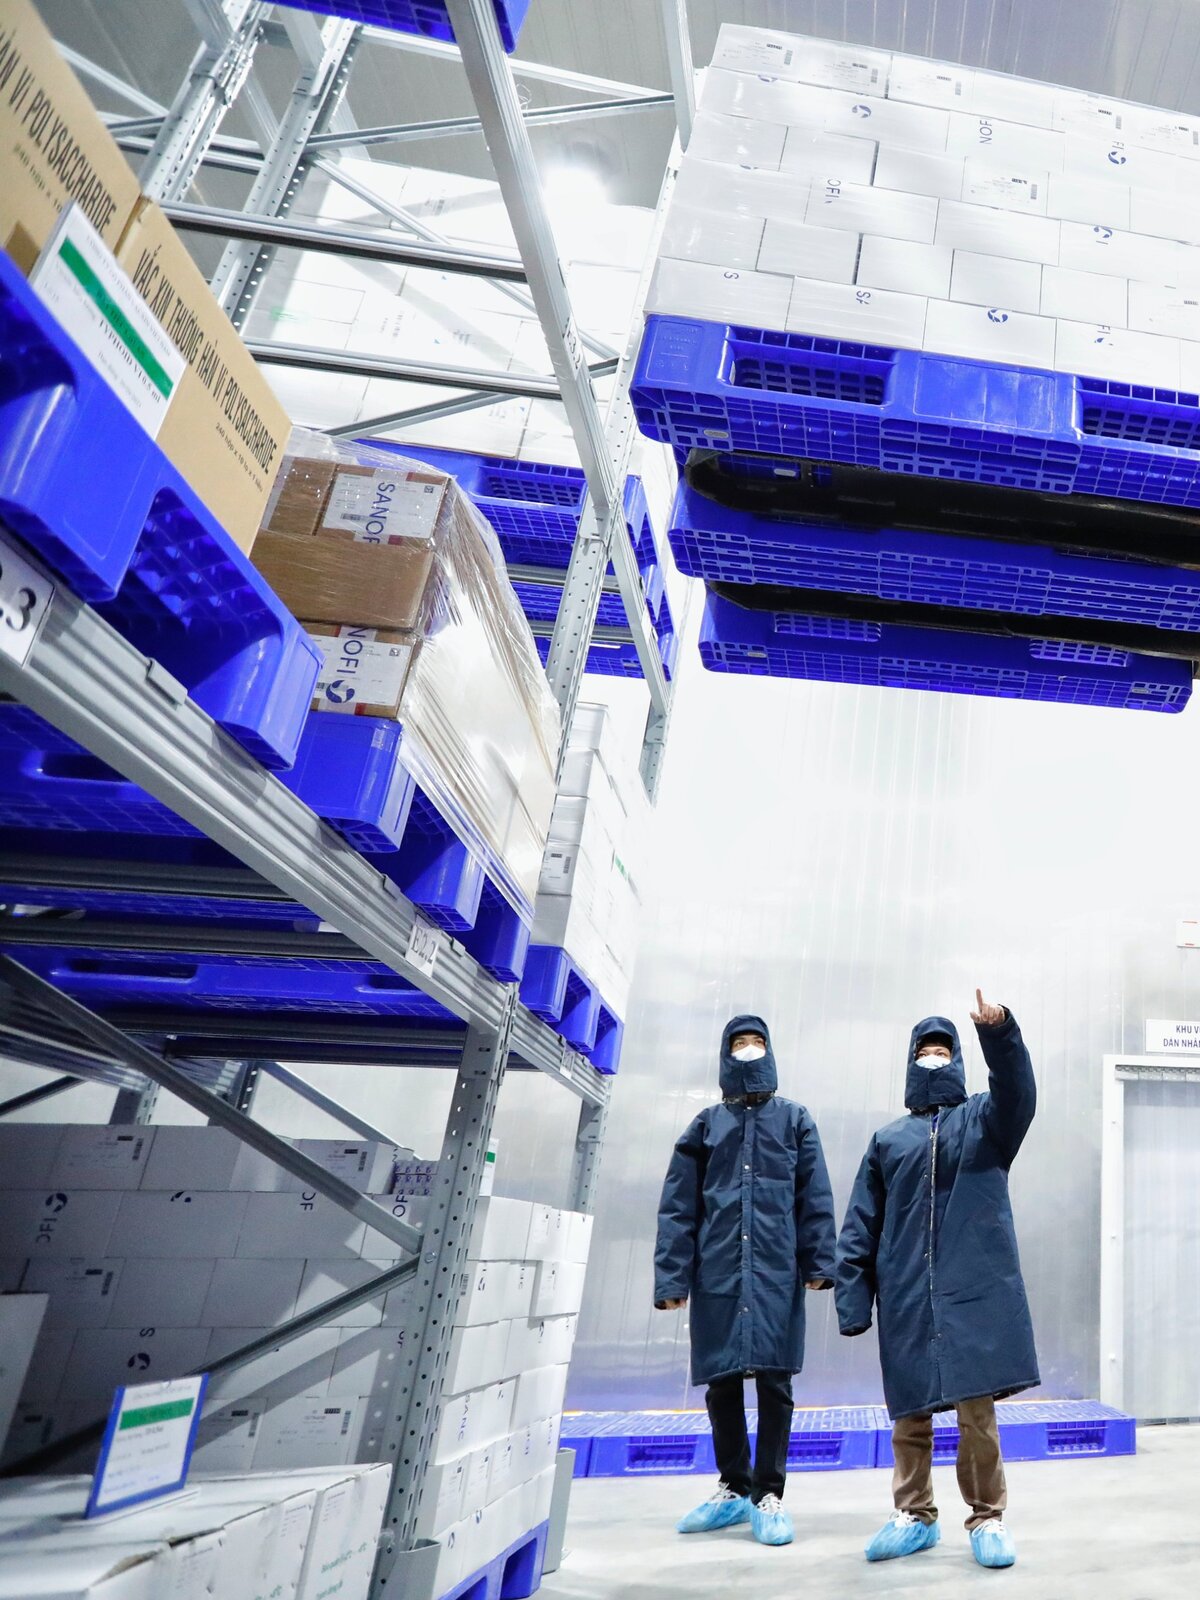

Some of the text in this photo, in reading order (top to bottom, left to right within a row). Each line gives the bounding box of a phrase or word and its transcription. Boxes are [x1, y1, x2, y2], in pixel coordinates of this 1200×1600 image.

[22, 89, 117, 238] POLYSACCHARIDE
[133, 244, 162, 301] VẮC
[151, 274, 175, 323] XIN
[196, 339, 220, 390] HÀN
[221, 377, 277, 475] POLYSACCHARIDE
[1176, 1025, 1192, 1034] KHU
